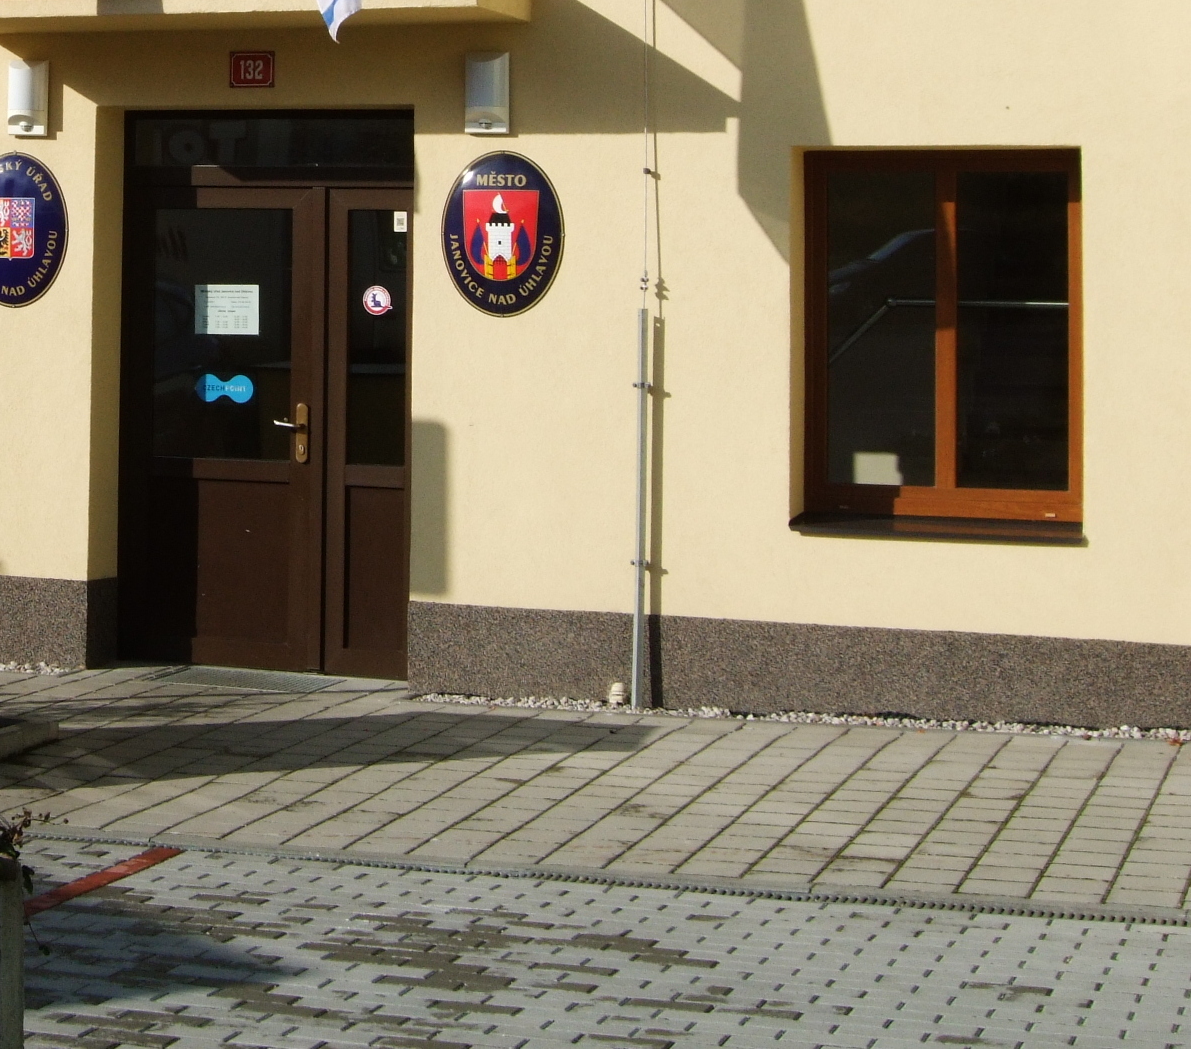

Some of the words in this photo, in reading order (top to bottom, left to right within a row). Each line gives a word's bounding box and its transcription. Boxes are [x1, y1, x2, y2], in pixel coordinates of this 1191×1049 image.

[240, 60, 264, 80] 132
[26, 166, 53, 202] ÚŘAD
[476, 170, 527, 187] MĚSTO
[1, 285, 26, 297] NAD
[29, 230, 58, 288] ÚHLAVOU
[450, 233, 485, 298] JANOVICE
[488, 293, 517, 306] NAD
[518, 234, 555, 297] ÚHLAVOU
